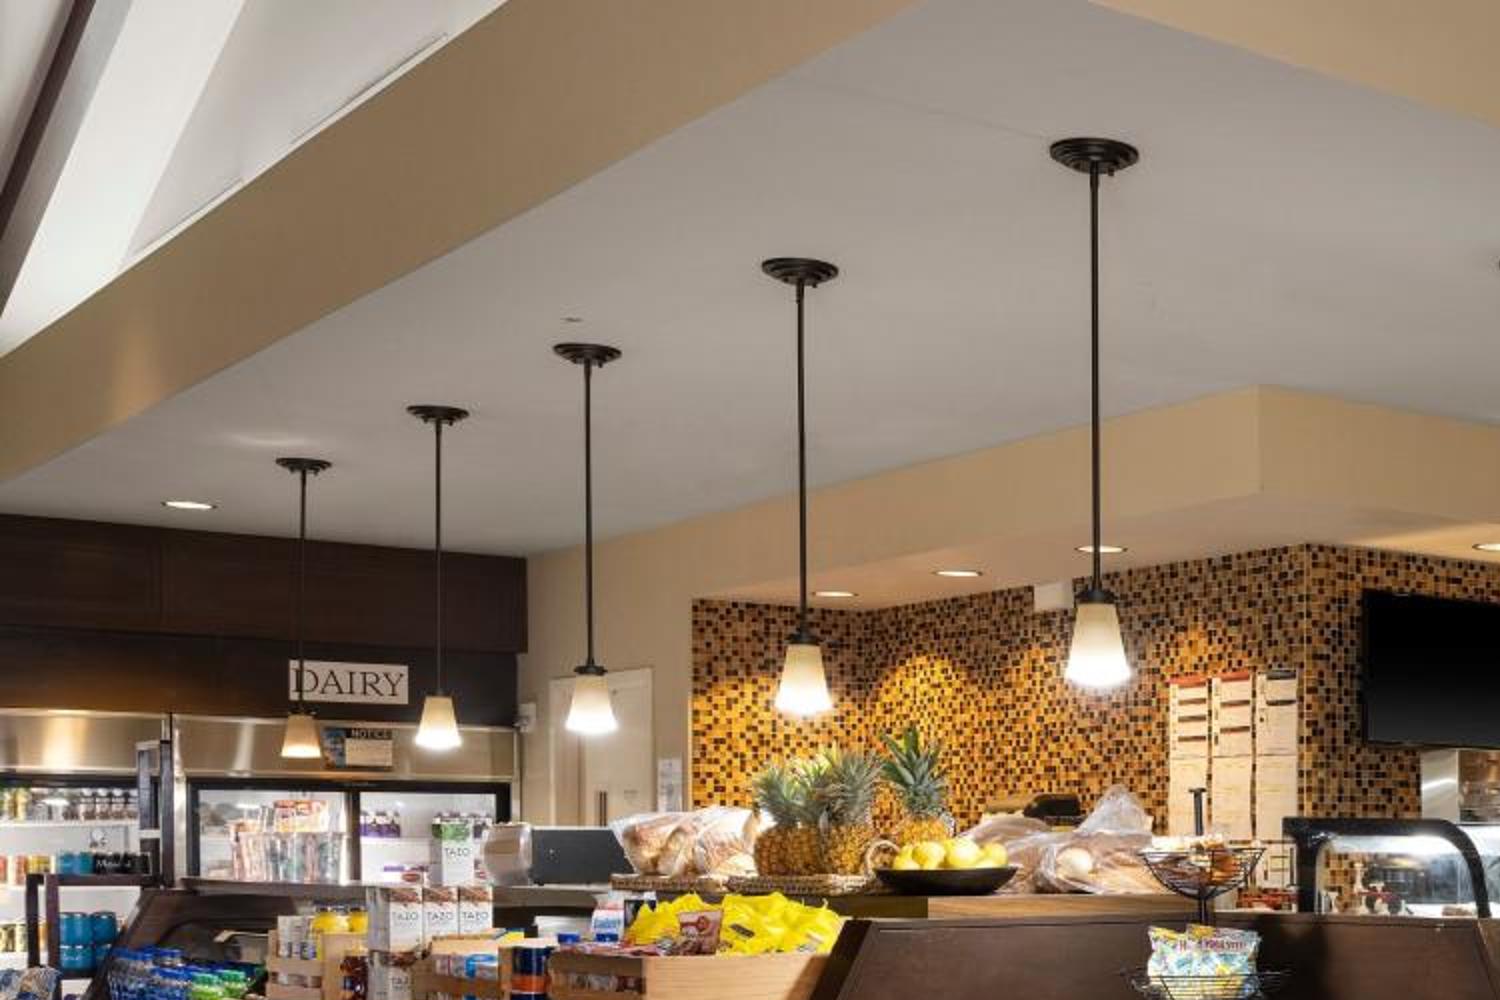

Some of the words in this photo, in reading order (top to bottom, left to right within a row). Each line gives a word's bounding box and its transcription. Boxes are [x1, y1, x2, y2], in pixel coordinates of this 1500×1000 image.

[291, 668, 404, 697] DAIRY
[445, 847, 470, 858] TAZO
[392, 911, 419, 922] TAZO
[427, 911, 454, 922] TAZO
[462, 911, 489, 922] TAZO
